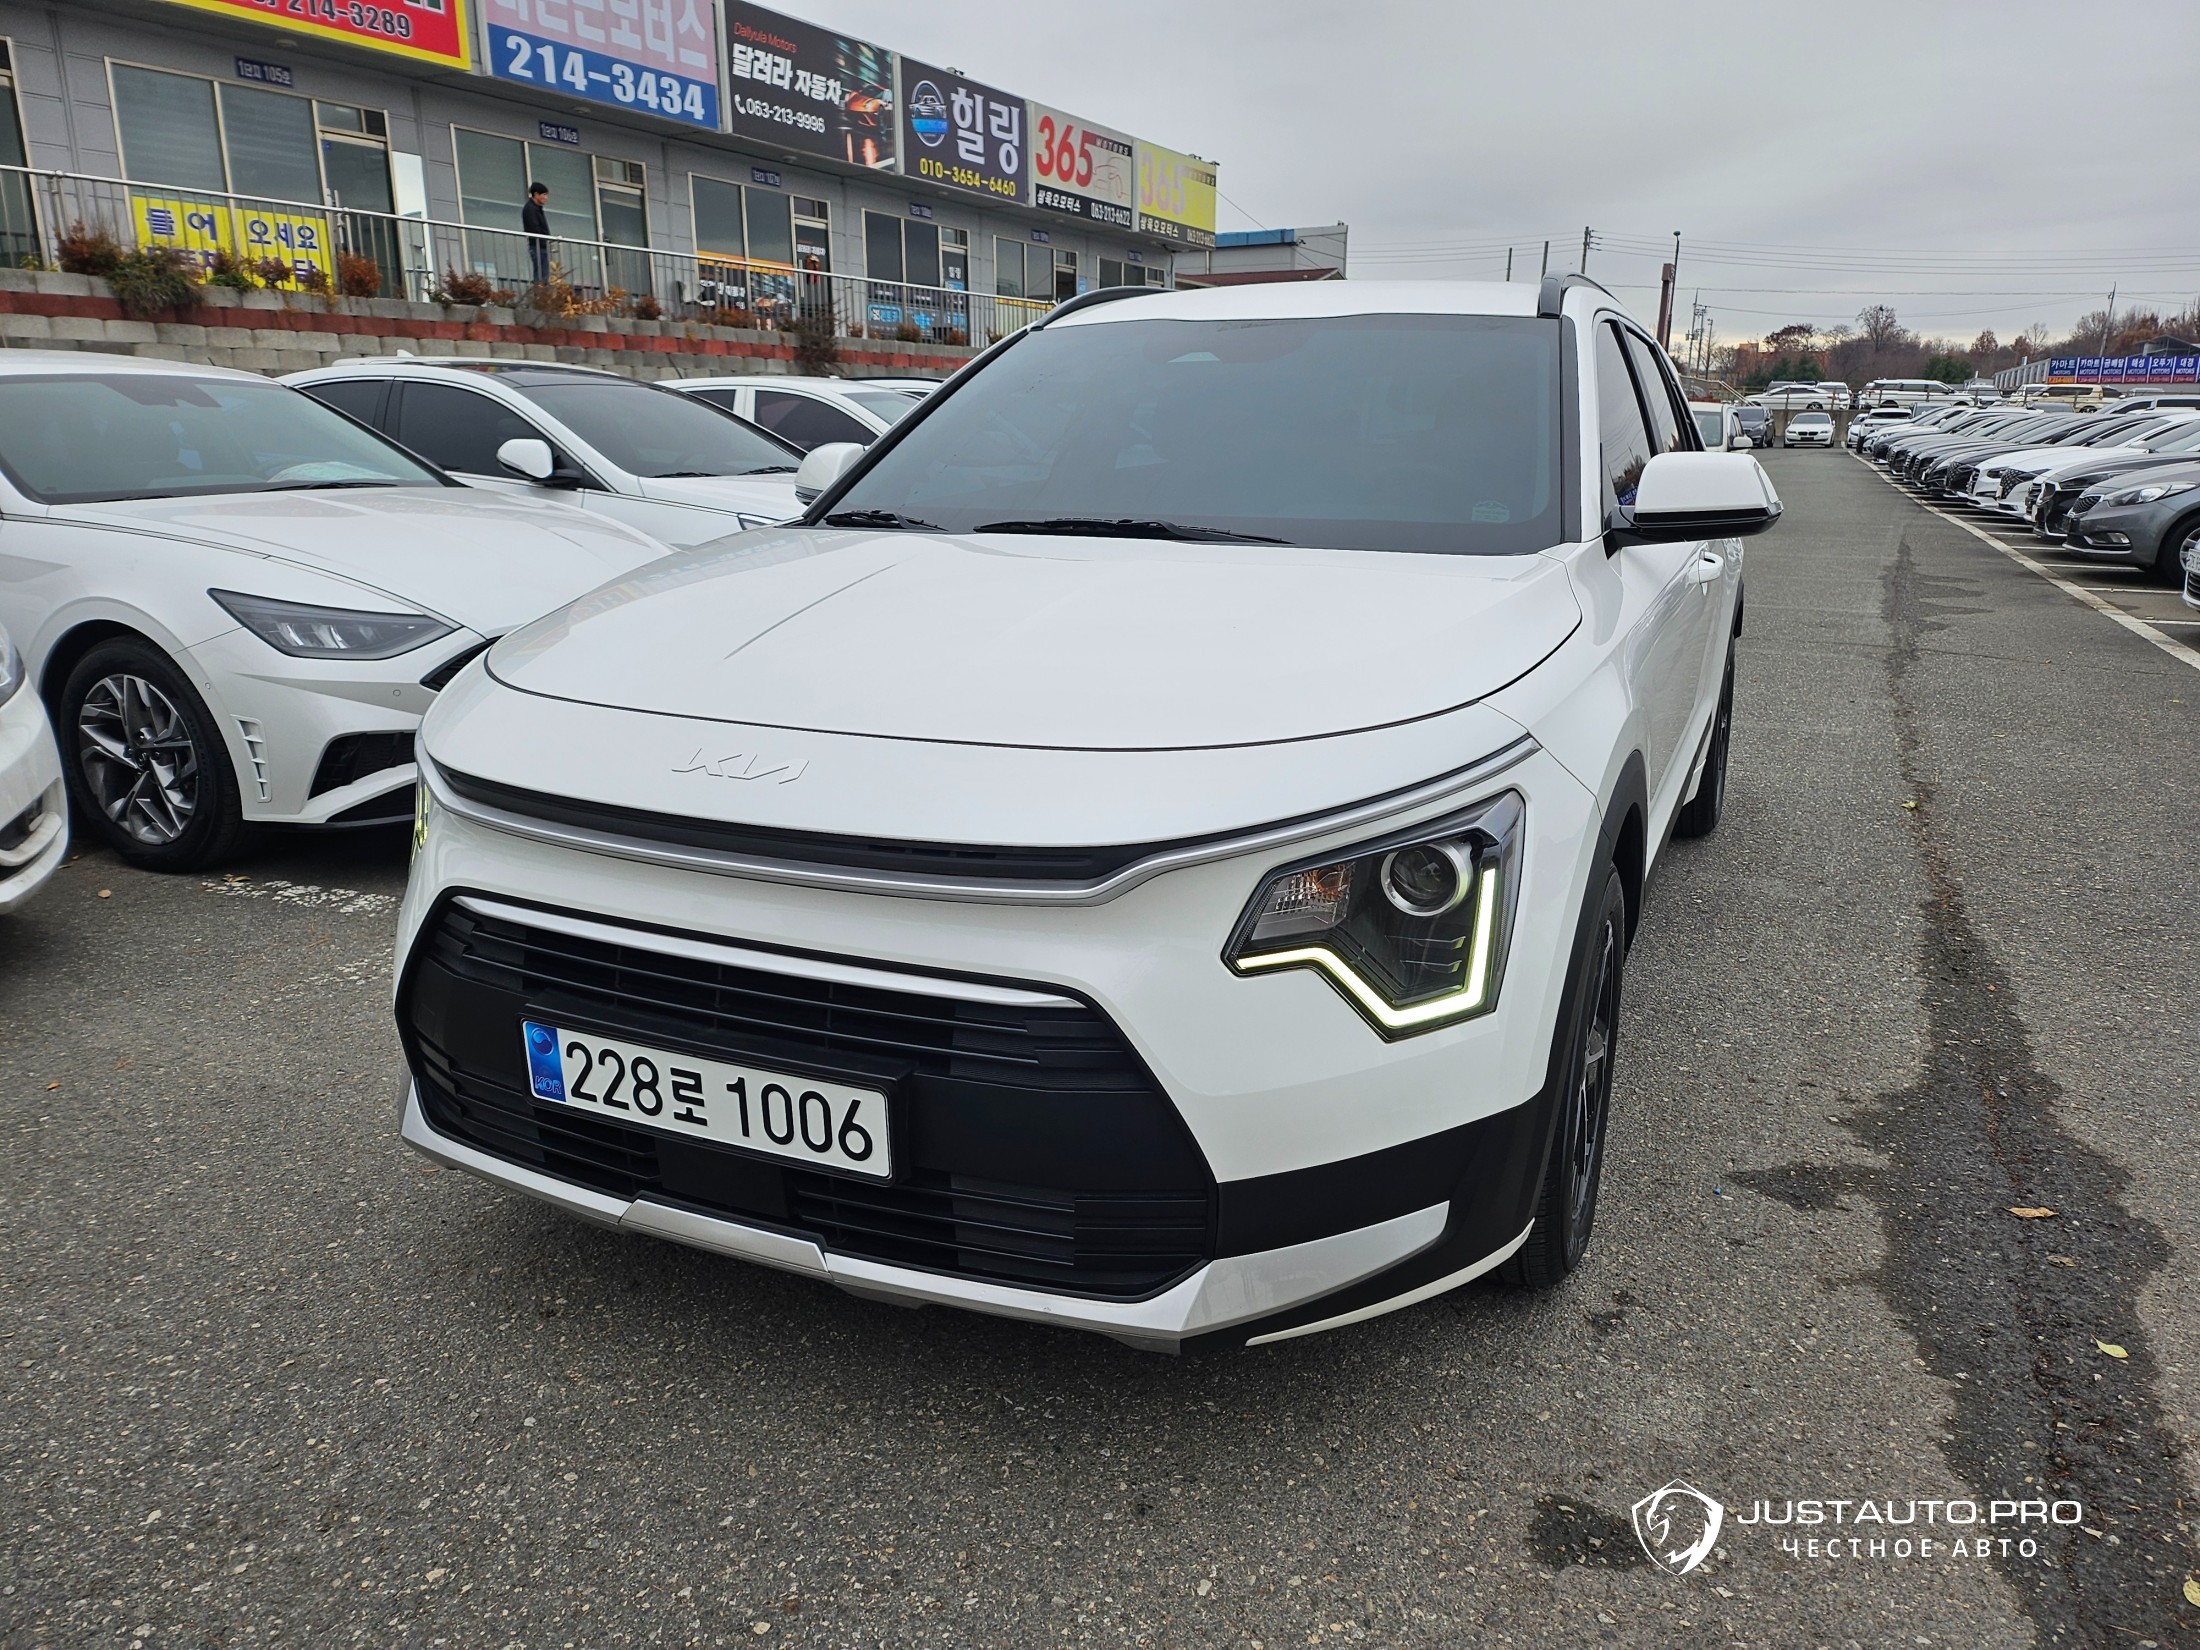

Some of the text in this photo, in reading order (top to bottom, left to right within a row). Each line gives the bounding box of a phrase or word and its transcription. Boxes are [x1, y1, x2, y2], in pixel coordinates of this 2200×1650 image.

[732, 43, 842, 105] 달려라 자동차
[767, 33, 797, 54] Motors
[506, 35, 705, 121] 214-3434
[746, 98, 825, 133] 063-213-9996
[950, 87, 1020, 174] 힐링
[920, 158, 1016, 196] 010-3654-6460
[1036, 115, 1094, 187] 365
[1140, 150, 1186, 216] 365
[249, 219, 318, 250] 오세요
[535, 1075, 562, 1095] KOR
[565, 1041, 873, 1162] 228로 1006
